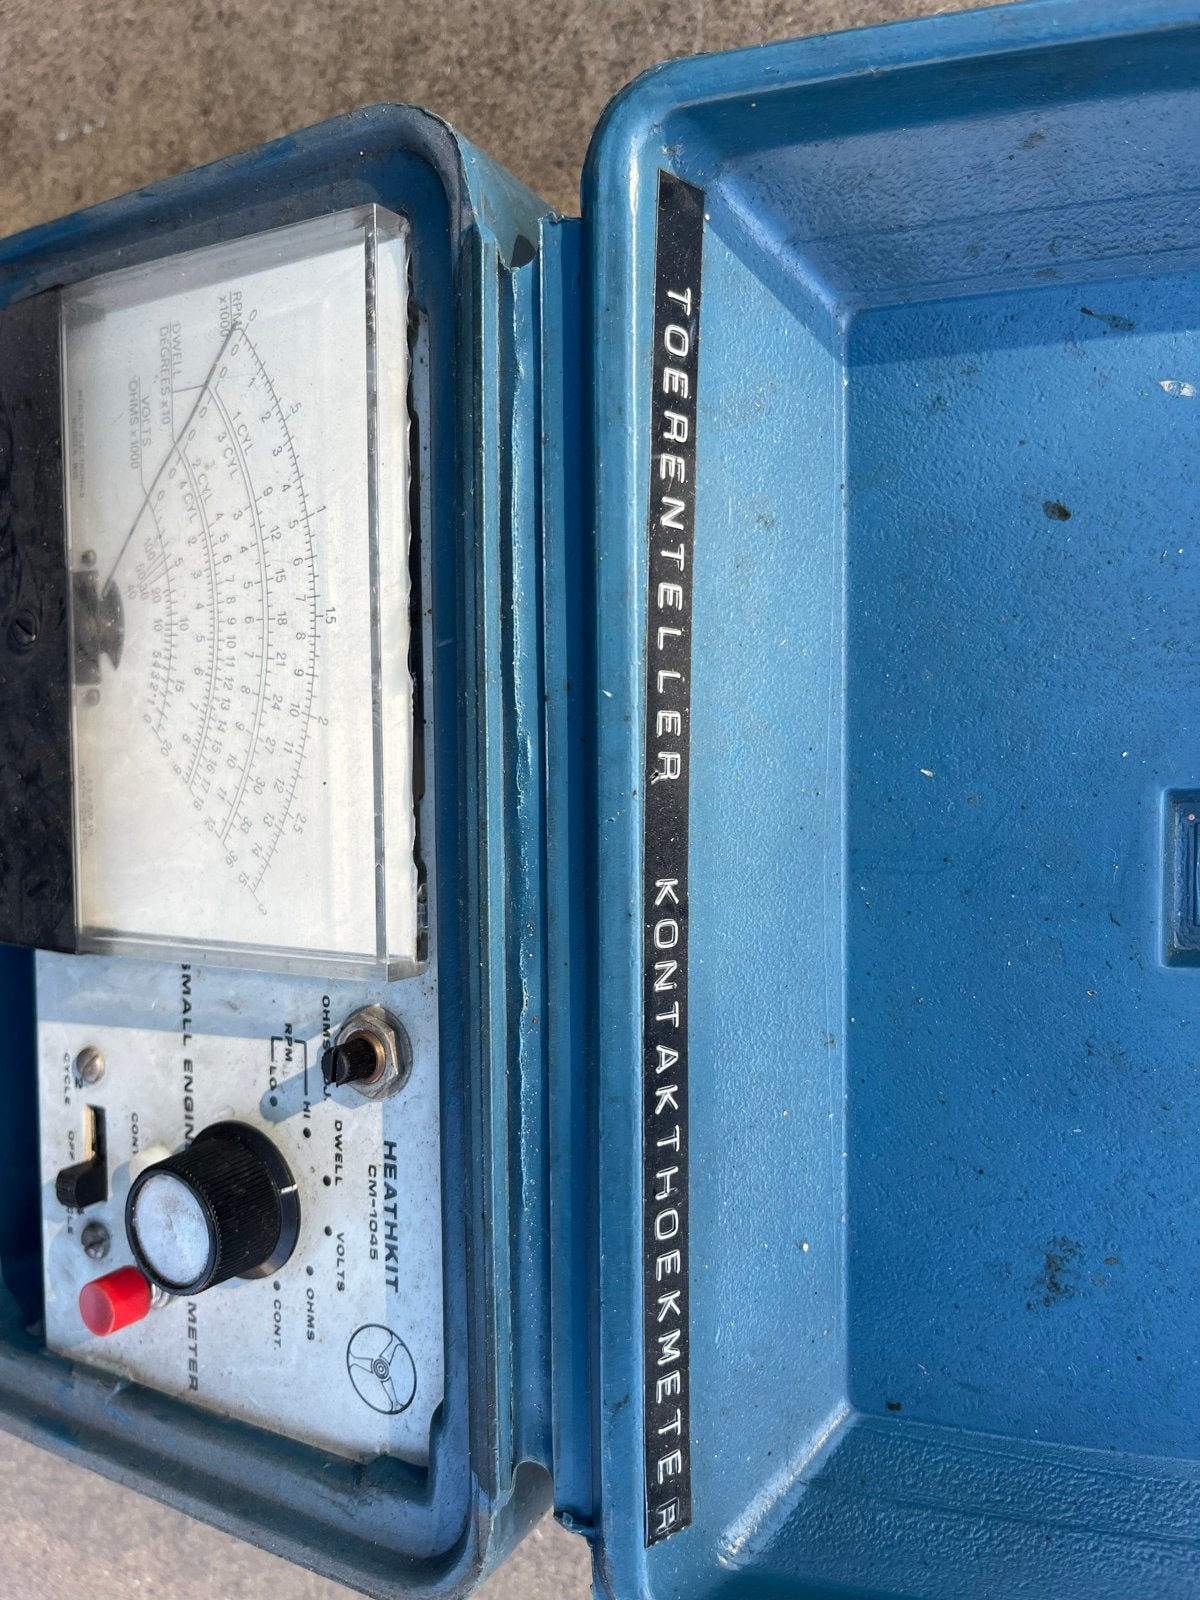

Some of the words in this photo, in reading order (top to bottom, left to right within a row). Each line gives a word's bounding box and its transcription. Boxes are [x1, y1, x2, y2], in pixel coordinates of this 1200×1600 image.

[232, 291, 242, 330] RPM
[250, 309, 257, 321] 0
[171, 323, 182, 376] DWELL
[231, 344, 239, 356] 0
[160, 326, 171, 396] DEGREES
[219, 367, 227, 378] 0
[248, 377, 256, 388] 1
[129, 380, 139, 426] OHMS
[200, 407, 207, 418] 0
[261, 412, 271, 423] 2
[141, 396, 151, 446] VOLTS
[189, 429, 196, 441] 0
[237, 424, 253, 456] CYL
[218, 432, 227, 443] 3
[224, 447, 240, 480] CYL
[273, 446, 283, 457] 3
[169, 468, 176, 479] 0
[192, 458, 201, 469] 2
[198, 474, 213, 505] CYL
[282, 484, 291, 492] 4
[158, 490, 165, 500] 0
[263, 486, 273, 497] 9
[179, 481, 187, 489] 4
[184, 493, 198, 523] CYL
[233, 510, 243, 520] 3
[289, 520, 299, 529] 5
[188, 536, 197, 547] 2
[220, 534, 229, 543] 5
[271, 526, 281, 542] 12
[651, 287, 691, 784] TOERENTELLER
[174, 557, 183, 567] 5
[223, 555, 232, 564] 6
[293, 557, 303, 566] 6
[192, 570, 202, 579] 3
[275, 568, 286, 583] 15
[243, 582, 253, 590] 5
[227, 617, 237, 626] 9
[244, 616, 254, 624] 6
[277, 611, 287, 625] 18
[326, 606, 336, 624] 1.5
[179, 617, 189, 631] 10
[196, 635, 205, 643] 5
[226, 635, 236, 648] 10
[296, 632, 306, 640] 8
[226, 655, 235, 668] 11
[244, 651, 254, 659] 7
[276, 652, 287, 667] 21
[194, 667, 203, 676] 6
[294, 669, 304, 677] 9
[175, 679, 185, 693] 15
[223, 676, 234, 691] 12
[241, 685, 251, 694] 8
[190, 702, 199, 710] 7
[221, 698, 231, 711] 13
[272, 694, 283, 711] 24
[290, 703, 300, 718] 10
[217, 719, 227, 733] 14
[235, 721, 245, 731] 9
[318, 716, 329, 726] 2
[182, 733, 191, 744] 8
[265, 736, 276, 755] 27
[160, 739, 172, 757] 20
[212, 739, 223, 754] 15
[284, 741, 294, 755] 11
[206, 759, 217, 774] 16
[227, 752, 238, 769] 10
[173, 764, 182, 775] 9
[200, 778, 211, 794] 17
[253, 777, 265, 795] 30
[274, 778, 285, 794] 12
[217, 787, 228, 801] 11
[193, 796, 204, 811] 18
[240, 816, 252, 834] 33
[263, 812, 275, 828] 13
[293, 812, 307, 835] 2.5
[252, 842, 263, 858] 14
[225, 850, 238, 868] 36
[238, 871, 250, 886] 15
[258, 904, 267, 915] 3
[322, 995, 331, 1050] OHMS
[284, 1023, 293, 1062] RPM
[63, 1052, 72, 1106] CYCLE
[269, 1066, 277, 1090] LO
[183, 1059, 195, 1150] ENGIN
[303, 1101, 311, 1118] HI
[68, 1130, 76, 1161] OFF
[334, 1120, 343, 1186] DWELL
[368, 1164, 378, 1261] CM-1045
[653, 878, 682, 1534] KONTAKTHOEKMETER
[383, 1140, 398, 1293] HEATHKIT
[336, 1232, 346, 1292] VOLTS
[307, 1288, 315, 1341] OHMS
[187, 1301, 199, 1392] METER
